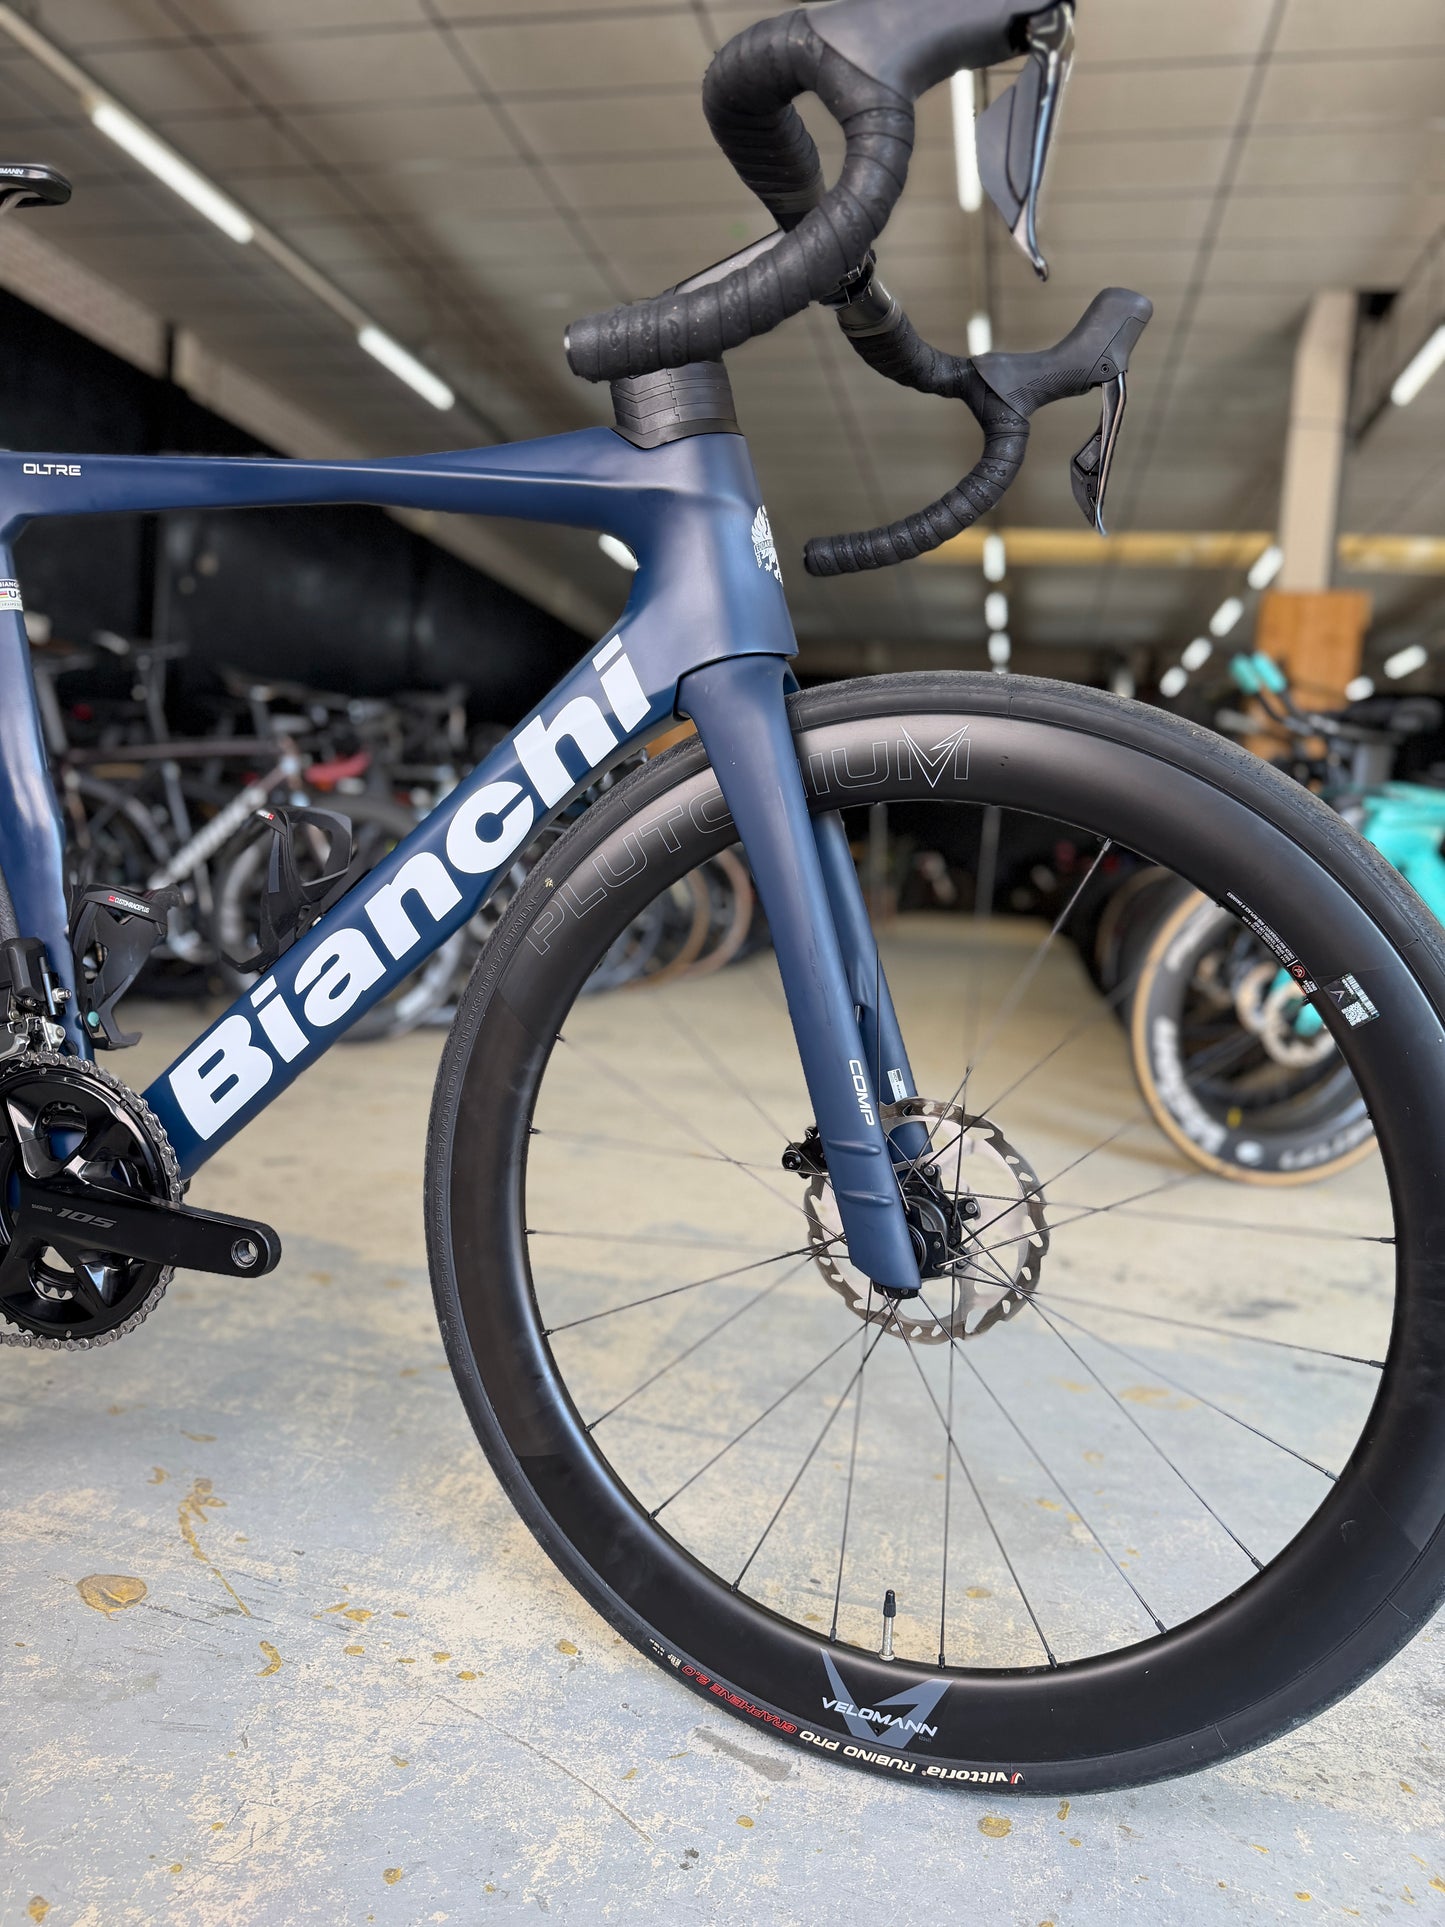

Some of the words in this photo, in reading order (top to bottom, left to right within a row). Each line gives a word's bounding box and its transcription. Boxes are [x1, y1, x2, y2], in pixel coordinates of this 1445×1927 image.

[23, 463, 82, 476] OLTRE
[169, 634, 651, 1140] Bianchi
[849, 1060, 875, 1126] COMP
[57, 1207, 117, 1229] 105
[682, 1665, 711, 1686] 2.0
[709, 1683, 797, 1734] GRAPHENE
[821, 1697, 938, 1738] VELOMANN
[800, 1730, 841, 1751] PRO
[843, 1745, 917, 1774] RUBINO
